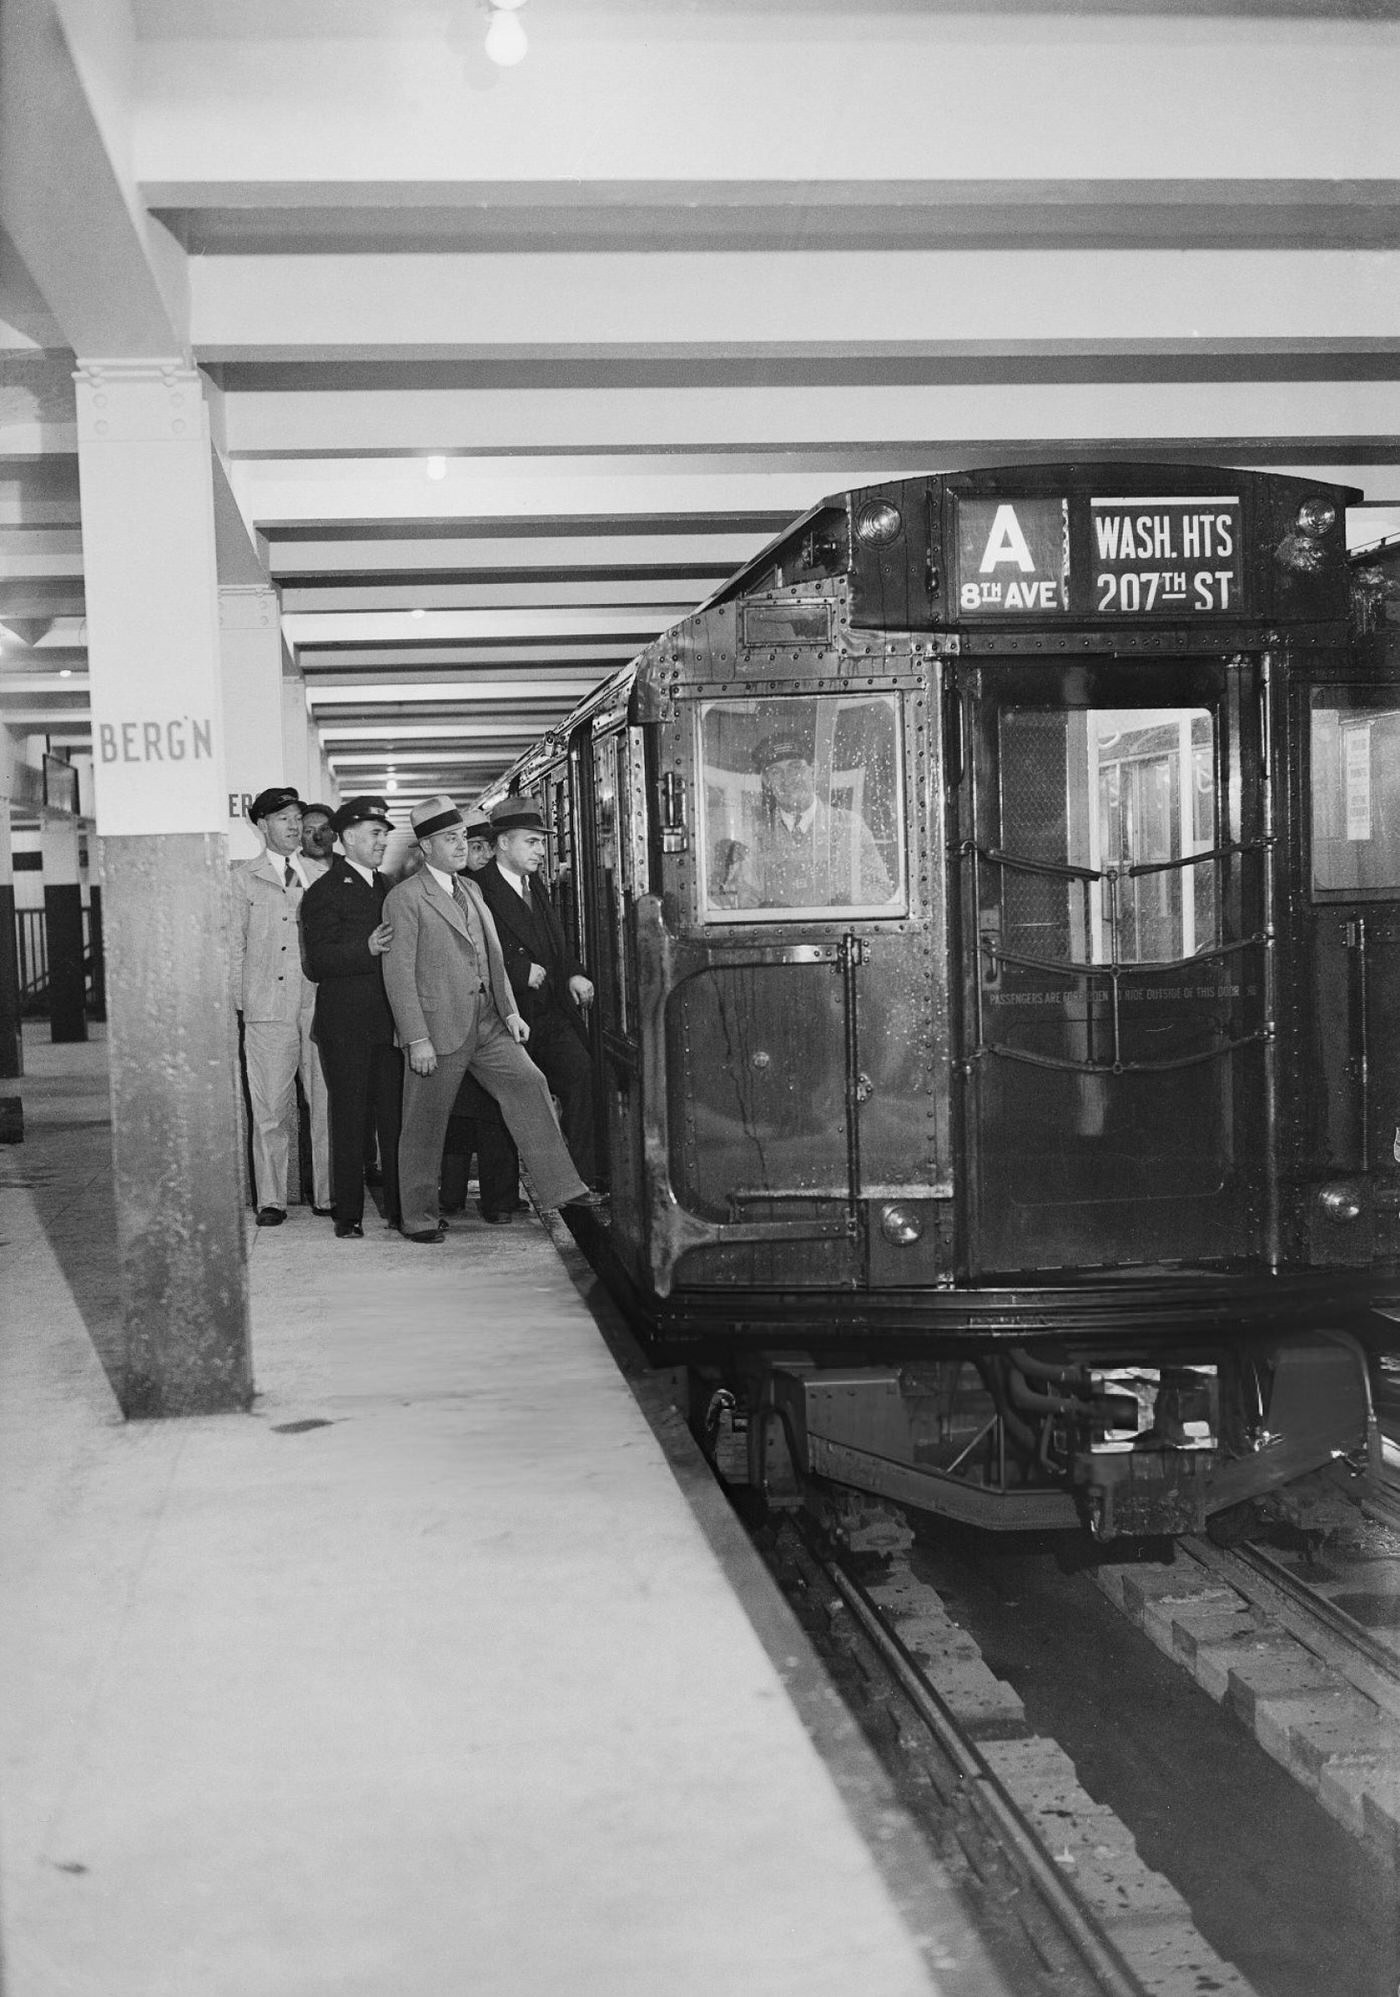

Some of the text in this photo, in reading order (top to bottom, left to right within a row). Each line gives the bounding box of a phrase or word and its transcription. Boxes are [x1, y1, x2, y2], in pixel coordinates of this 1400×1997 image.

[979, 504, 1036, 573] A
[1095, 514, 1233, 560] WASH. HTS
[960, 581, 1058, 610] 8TH AVE
[1097, 571, 1233, 612] 207TH ST
[99, 716, 212, 763] BERG'N
[228, 793, 262, 818] ER
[989, 993, 1043, 1005] PASSENGERS
[1045, 991, 1062, 1004] ARE
[1063, 990, 1109, 1003] FORBDEN
[1125, 989, 1145, 1001] RIDE
[1196, 985, 1215, 999] THIS
